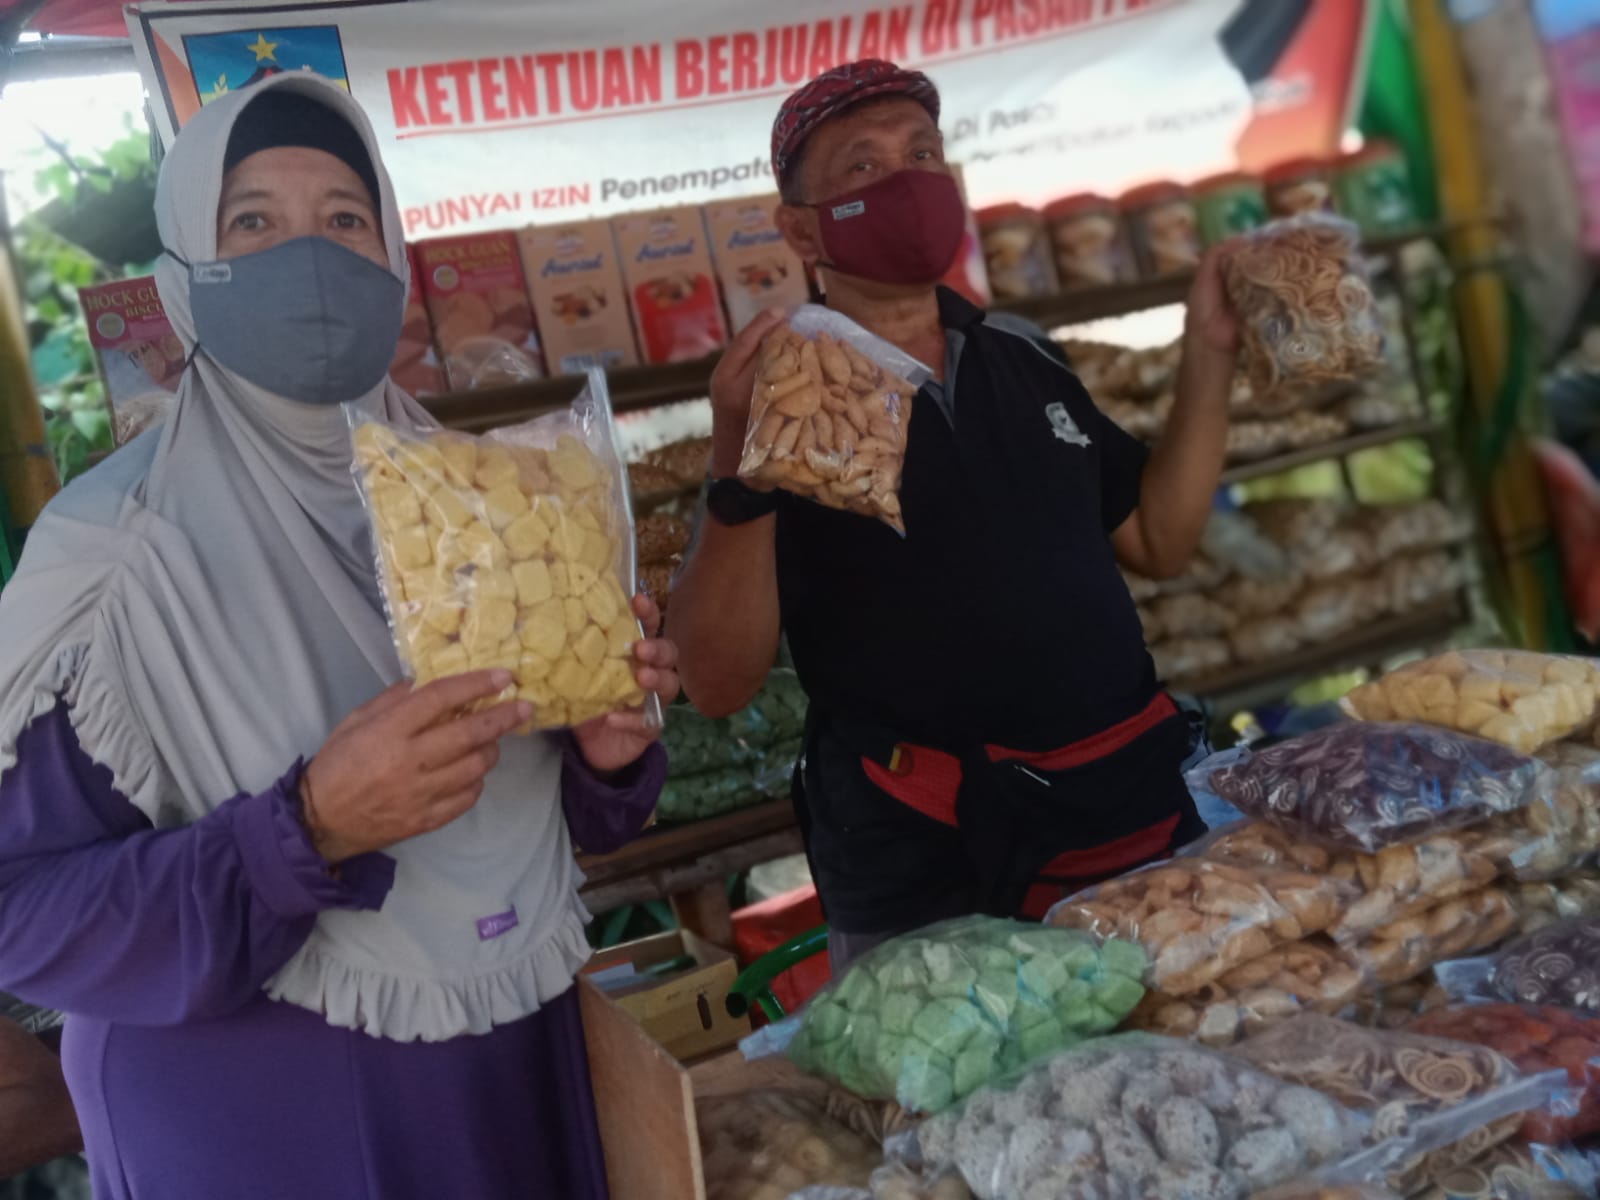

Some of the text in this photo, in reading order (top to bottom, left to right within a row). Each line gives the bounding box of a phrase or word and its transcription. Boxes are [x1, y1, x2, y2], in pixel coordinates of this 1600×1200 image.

[387, 43, 661, 129] KETENTUAN
[675, 5, 913, 101] BERJUALAN
[920, 0, 961, 56] DI
[404, 191, 522, 234] PUNYAI
[531, 183, 592, 210] IZIN
[86, 290, 133, 312] HOCK
